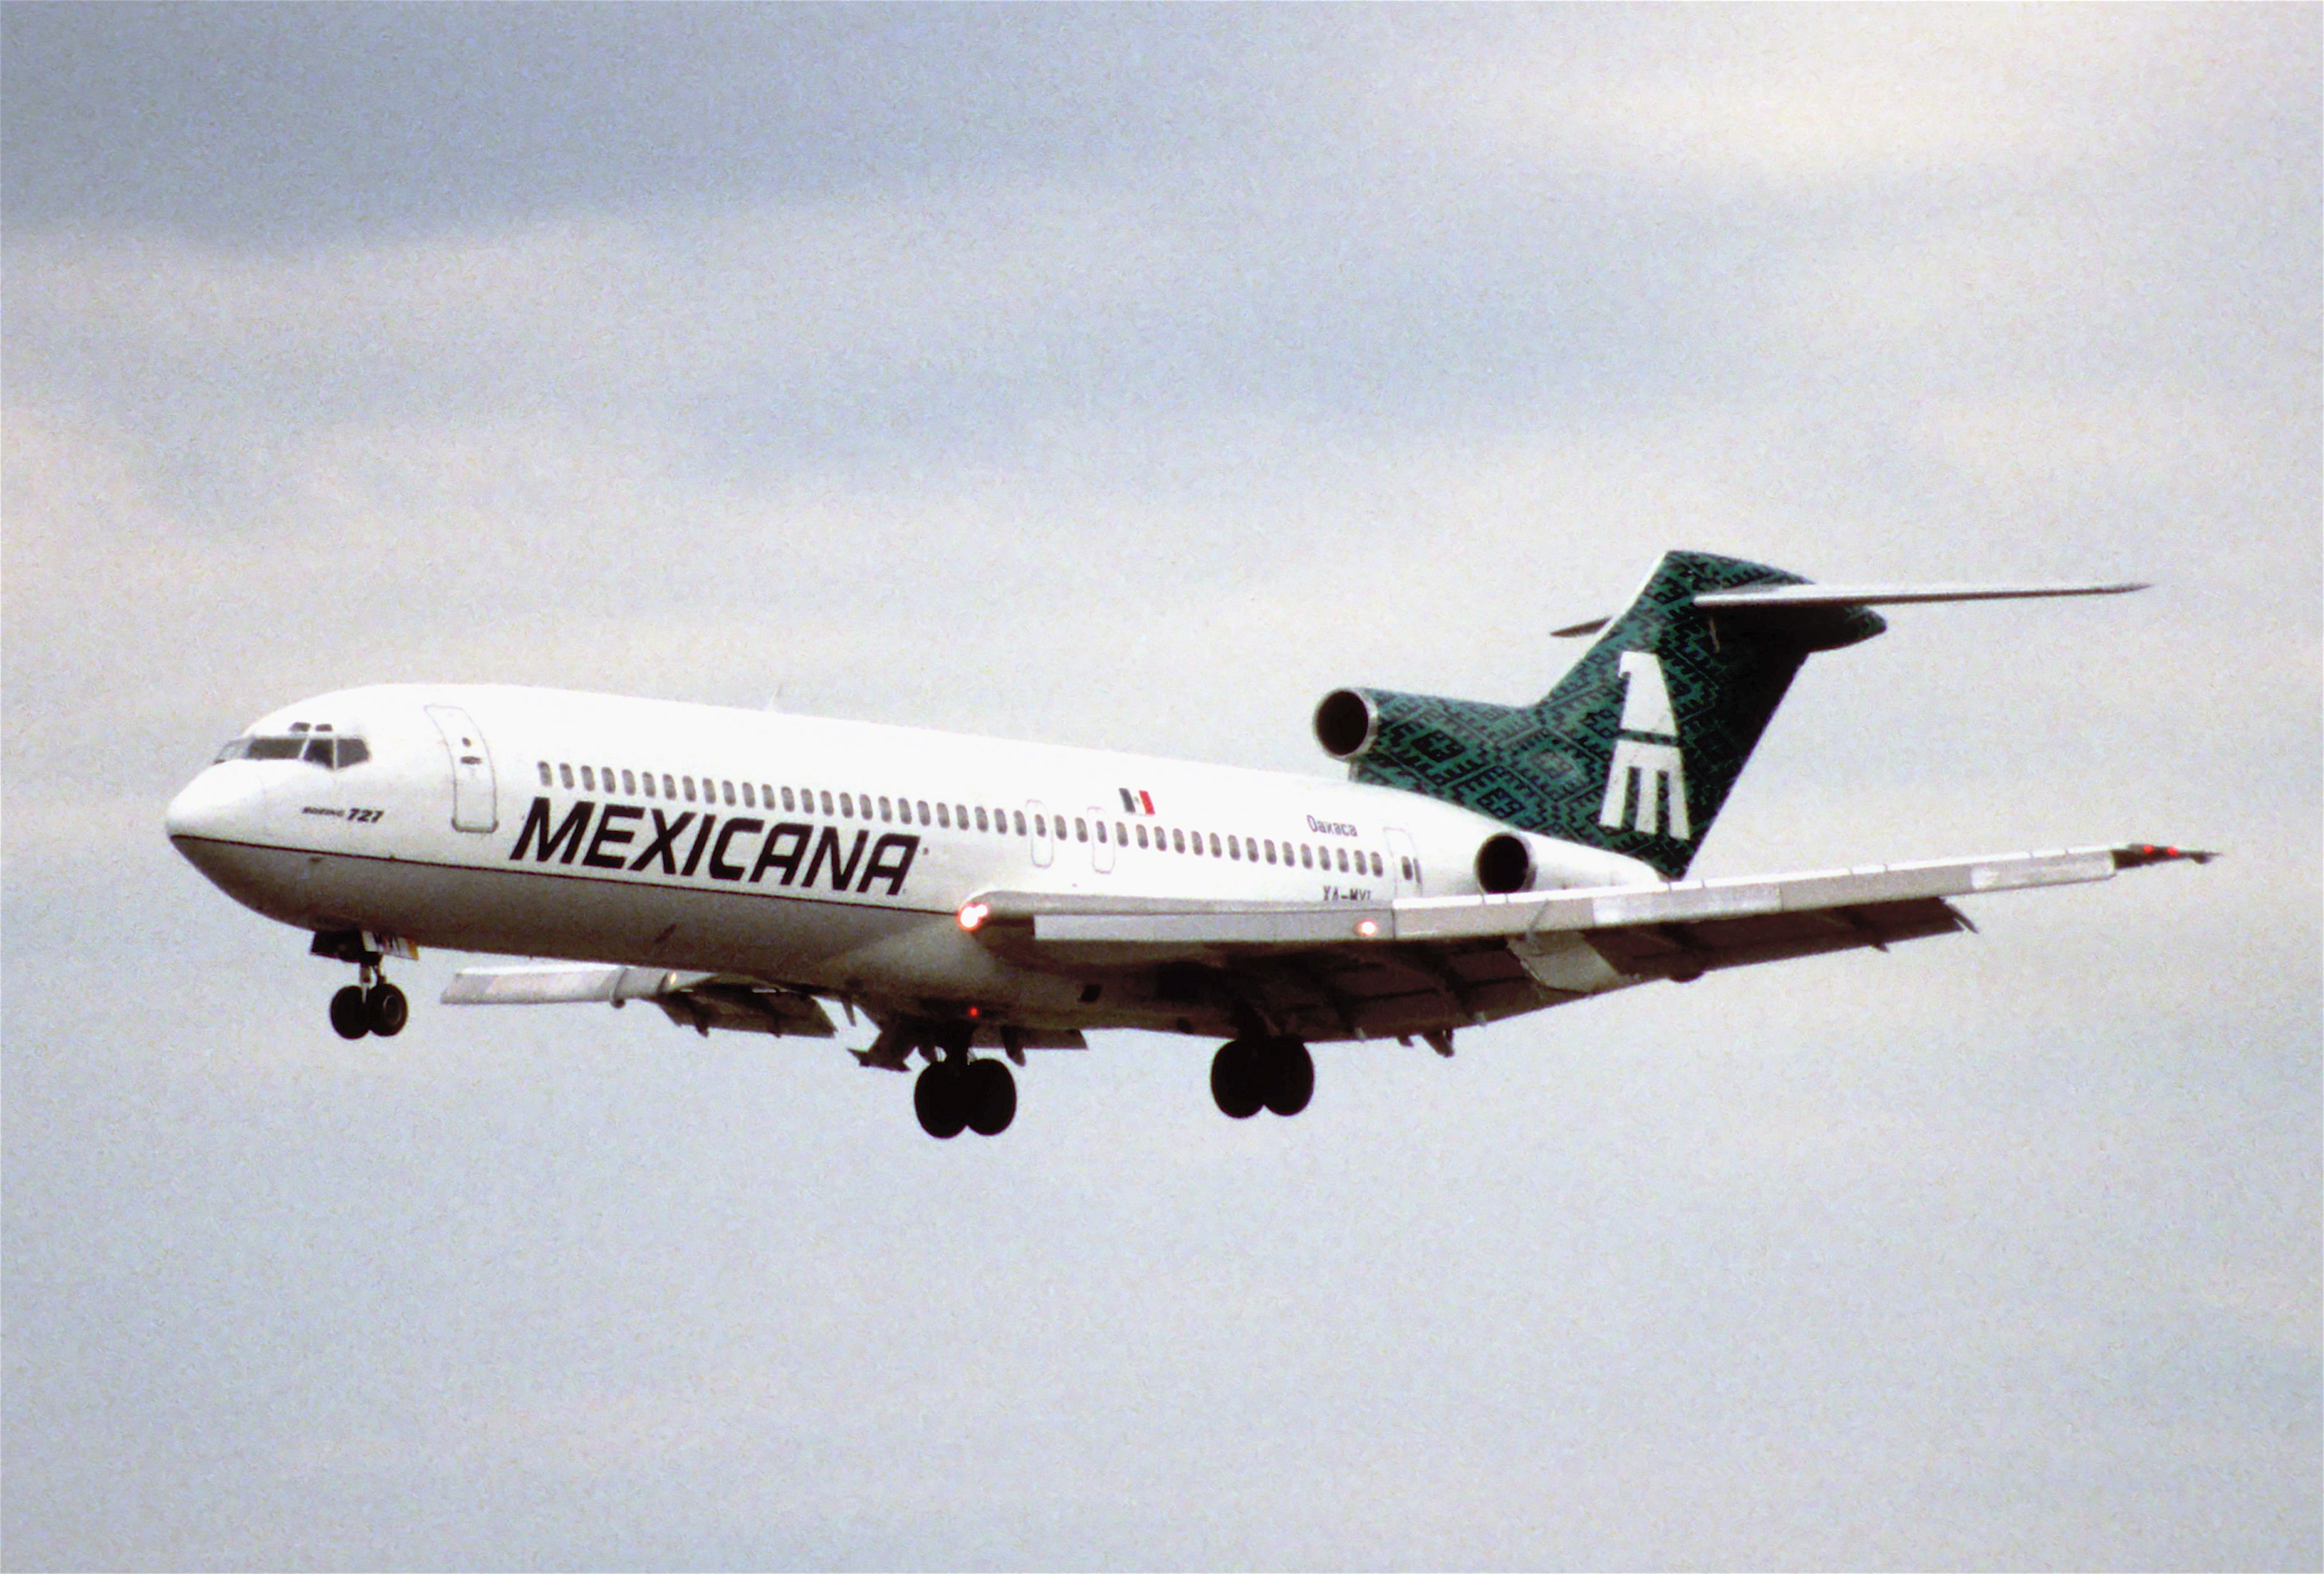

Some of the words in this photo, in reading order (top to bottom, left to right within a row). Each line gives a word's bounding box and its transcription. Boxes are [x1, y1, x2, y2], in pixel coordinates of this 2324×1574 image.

[347, 807, 385, 824] 727
[1306, 814, 1358, 836] Oaxaca
[509, 796, 920, 895] MEXICANA
